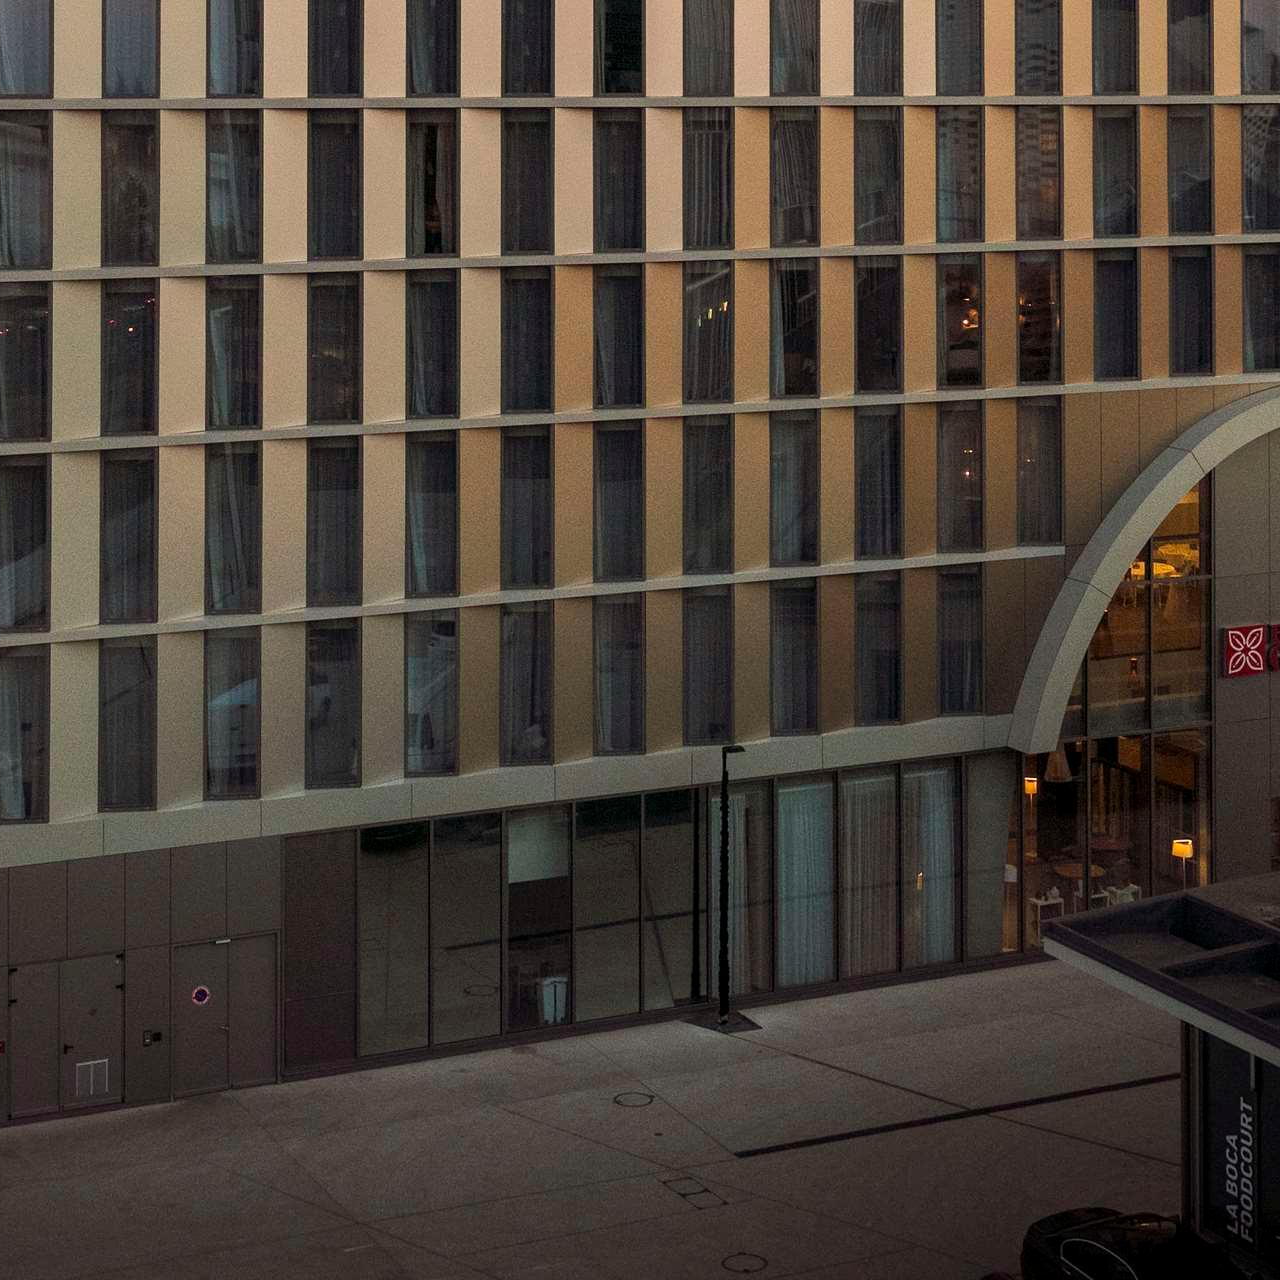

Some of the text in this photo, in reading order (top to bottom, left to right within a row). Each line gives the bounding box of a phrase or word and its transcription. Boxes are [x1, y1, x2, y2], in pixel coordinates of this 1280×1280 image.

[1226, 1134, 1239, 1235] LA BOCA
[1240, 1096, 1254, 1243] FOODCOURT
